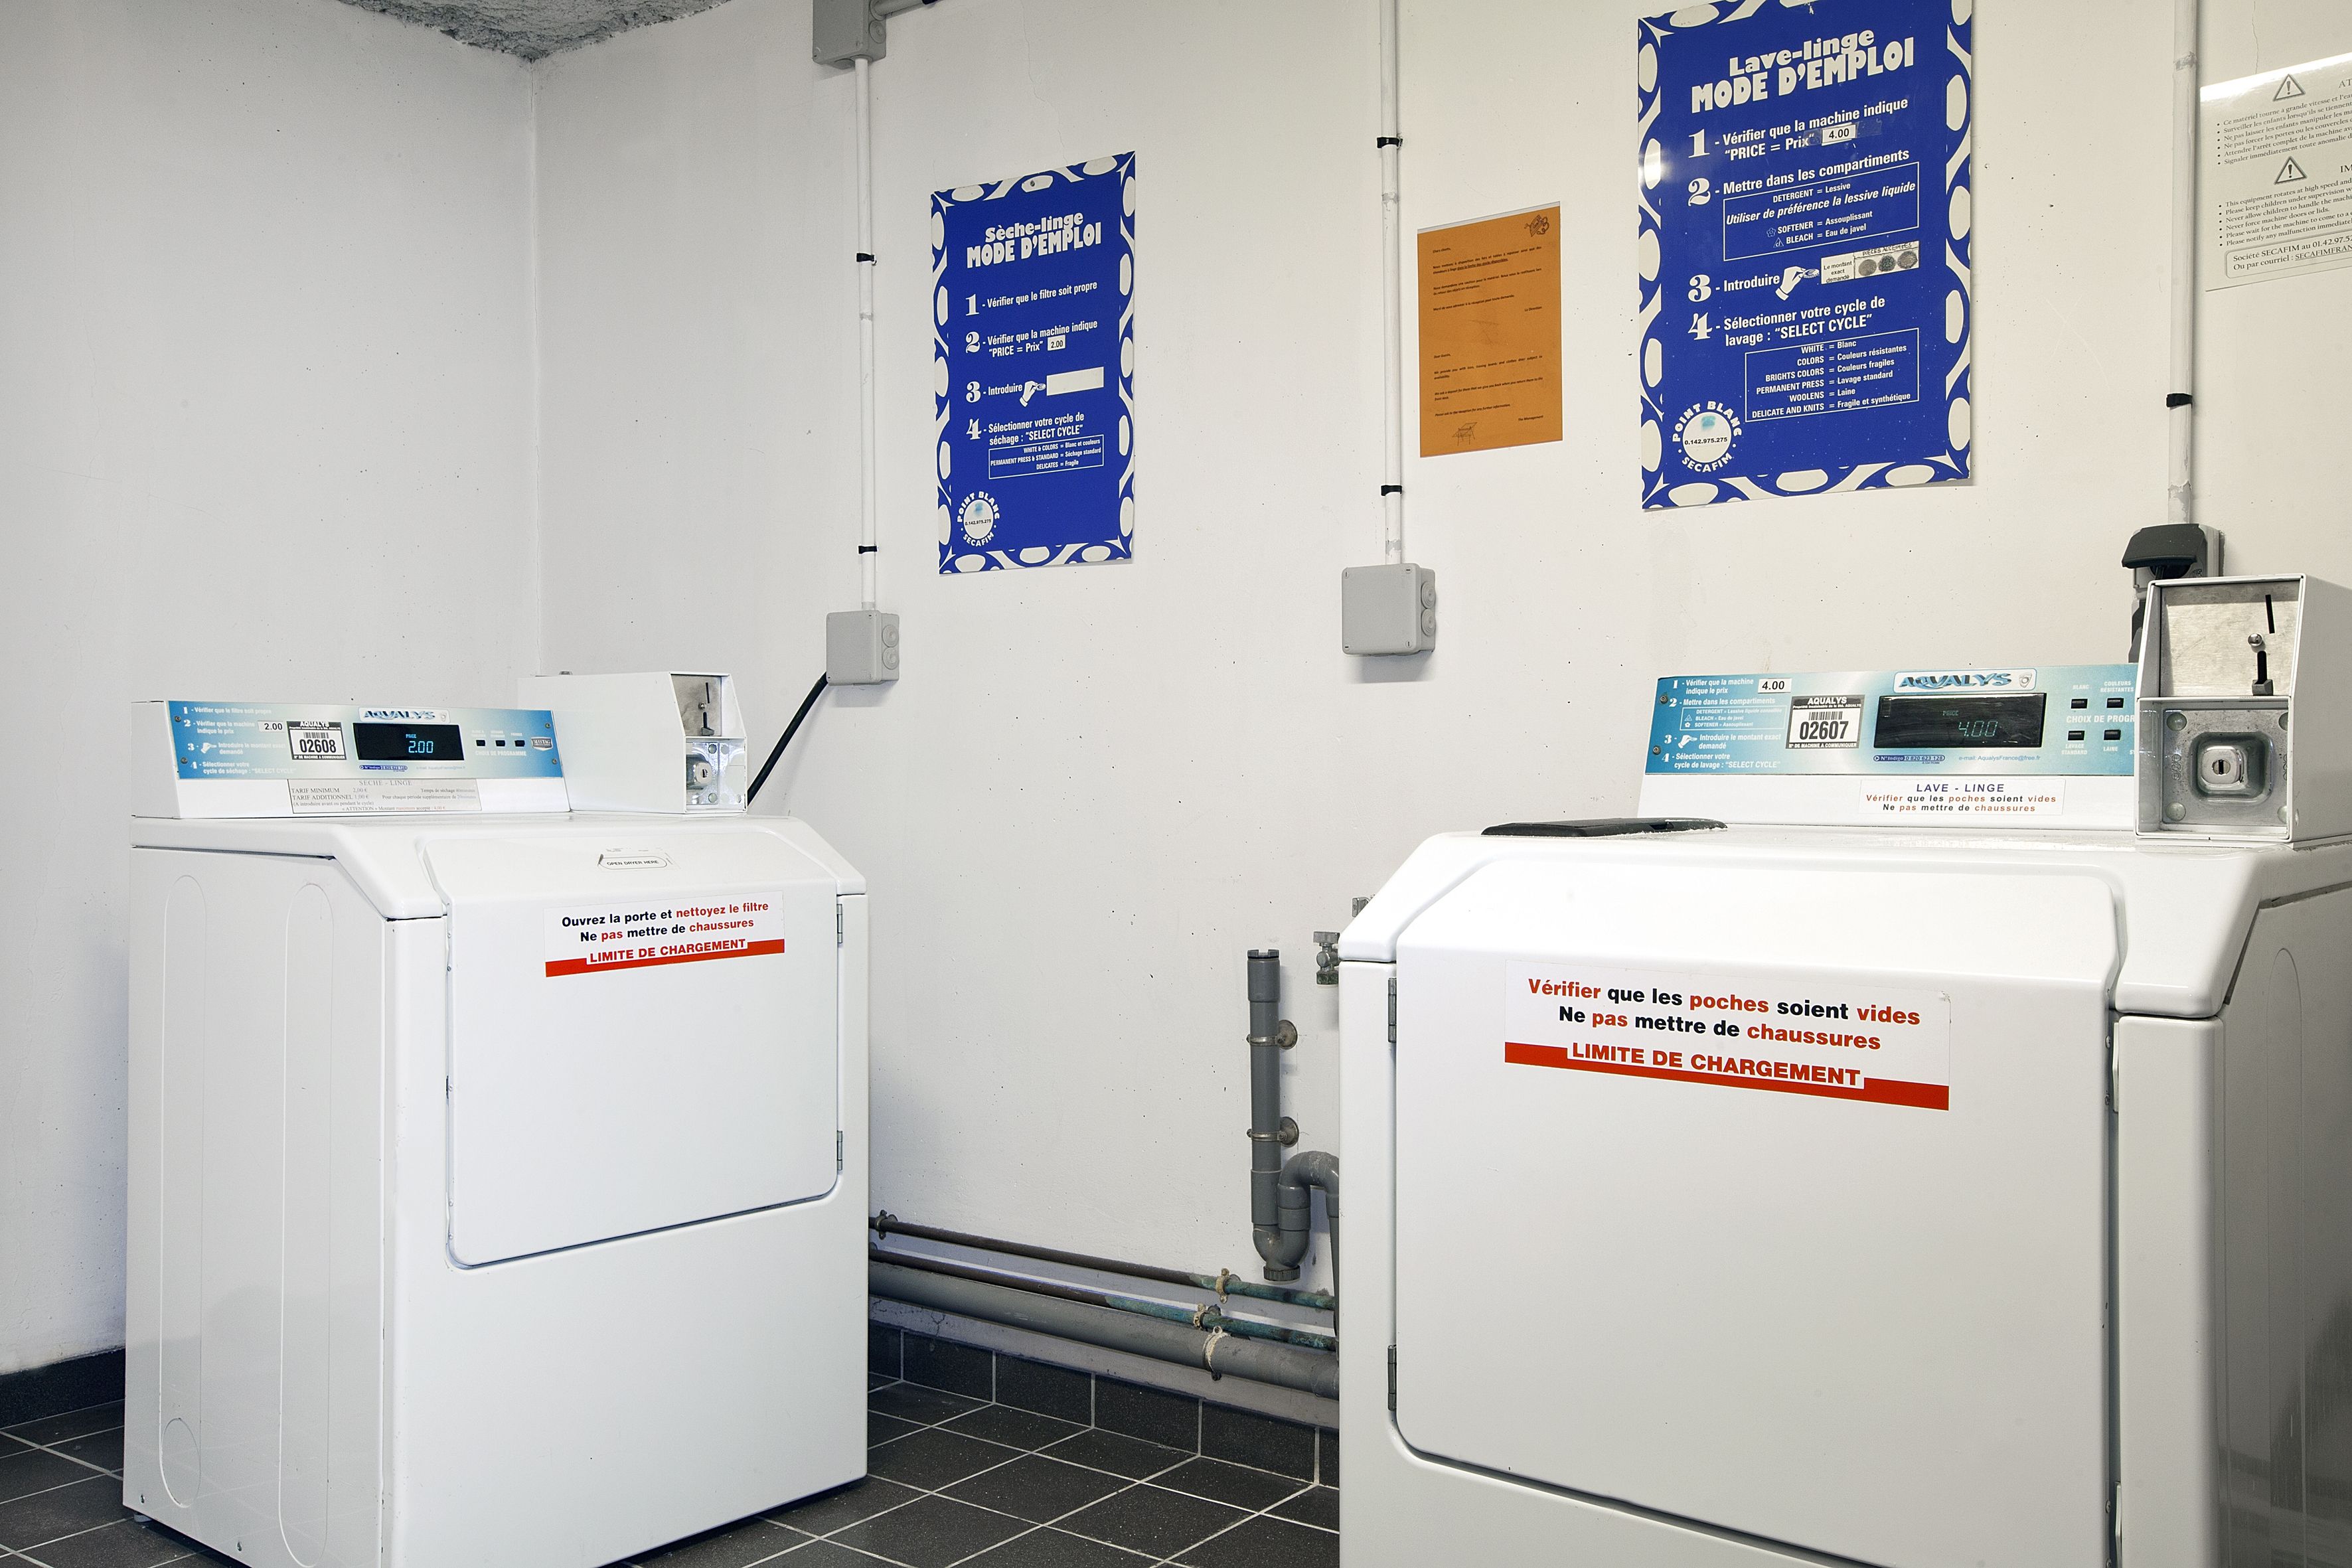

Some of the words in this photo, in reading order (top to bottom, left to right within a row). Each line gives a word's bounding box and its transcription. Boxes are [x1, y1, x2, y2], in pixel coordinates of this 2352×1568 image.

[1729, 29, 1874, 77] Lave-linge
[1691, 69, 1768, 114] MODE
[1778, 37, 1914, 97] D'EMPLOI
[1688, 127, 1710, 159] 1
[1723, 129, 1766, 145] Vérifier
[1769, 125, 1791, 139] que
[1794, 119, 1805, 132] la
[1809, 110, 1859, 129] machine
[1864, 99, 1908, 117] indique
[1828, 127, 1850, 139] 4.00
[1687, 177, 1711, 206] 2
[1723, 180, 1763, 195] Mettre
[1766, 174, 1794, 187] dans
[1798, 169, 1815, 181] les
[1819, 150, 1909, 177] compartiments
[1726, 212, 1761, 225] Utiliser
[1763, 208, 1775, 219] de
[1777, 200, 1830, 218] préférence
[1832, 196, 1842, 206] la
[1844, 190, 1879, 204] lessive
[1881, 181, 1916, 197] liquide
[1773, 189, 1814, 203] DETERGENT
[1826, 183, 1851, 193] Lessive
[984, 212, 1083, 243] Sèche-linge
[1778, 221, 1814, 234] SOFTENER
[1825, 210, 1873, 226] Assouplissant
[1786, 232, 1813, 244] BLEACH
[1849, 223, 1866, 234] javel
[967, 240, 1015, 268] MODE
[1021, 222, 1101, 259] D'EMPLOI
[2233, 253, 2260, 262] Société
[2261, 244, 2300, 257] SECAFIM
[965, 294, 980, 316] 1
[987, 296, 1014, 308] Vérifier
[1016, 295, 1029, 305] que
[1031, 291, 1038, 301] le
[1040, 289, 1057, 299] filtre
[1058, 285, 1072, 295] soit
[1074, 282, 1097, 295] propre
[1687, 274, 1712, 303] 3
[1723, 274, 1780, 293] Introduire
[1687, 311, 1713, 341] 4
[1724, 312, 1797, 331] Sélectionner
[1800, 307, 1831, 319] votre
[1835, 299, 1867, 316] cycle
[1871, 296, 1885, 309] de
[965, 331, 980, 354] 2
[987, 334, 1014, 345] Vérifier
[1016, 333, 1029, 343] que
[1031, 329, 1038, 339] la
[1040, 325, 1069, 337] machine
[1071, 321, 1097, 332] indique
[1050, 339, 1063, 349] 2.00
[1725, 333, 1763, 347] lavage
[1800, 343, 1824, 354] WHITE
[1836, 339, 1857, 349] Blanc
[966, 381, 981, 403] 3
[988, 383, 1023, 396] Introduire
[966, 418, 982, 441] 4
[988, 421, 1033, 433] Sélectionner
[1034, 418, 1053, 427] votre
[1054, 413, 1073, 426] cycle
[1075, 412, 1084, 422] de
[1672, 403, 1701, 443] POINT
[1706, 401, 1742, 437] BLANC
[989, 435, 1019, 445] séchage
[1684, 436, 1728, 445] 0.142.975.275
[1681, 452, 1733, 473] SECAFIM
[957, 493, 975, 523] POINT
[978, 490, 1000, 520] BLANC
[963, 532, 994, 547] SECAFIM
[1762, 680, 1785, 690] 4.00
[1807, 696, 1847, 706] AQUALYS
[1800, 720, 1848, 740] 02607
[299, 739, 337, 753] 02608
[408, 740, 433, 754] 2.00
[1948, 795, 1985, 803] poches
[562, 917, 605, 927] Ouvrez
[609, 913, 621, 923] la
[625, 911, 657, 925] porte
[661, 909, 672, 919] et
[676, 907, 726, 917] nettoyez
[730, 904, 739, 913] le
[742, 902, 769, 912] filtre
[580, 931, 597, 942] Ne
[601, 931, 623, 942] pas
[627, 926, 668, 938] mettre
[671, 924, 686, 934] de
[689, 919, 754, 932] chaussures
[589, 949, 635, 963] LIMITE
[638, 947, 655, 959] DE
[659, 939, 746, 957] CHARGEMENT
[1528, 979, 1601, 998] Vérifier
[1608, 988, 1645, 1004] que
[1652, 988, 1682, 1006] les
[1690, 994, 1769, 1012] poches
[1777, 999, 1849, 1020] soient
[1857, 1004, 1920, 1025] vides
[1559, 1006, 1585, 1023] Ne
[1593, 1013, 1628, 1028] pas
[1635, 1016, 1706, 1034] mettre
[1713, 1020, 1740, 1037] de
[1747, 1023, 1881, 1050] chaussures
[1572, 1042, 1645, 1064] LIMITE
[1652, 1049, 1683, 1069] DE
[1690, 1054, 1861, 1086] CHARGEMENT
